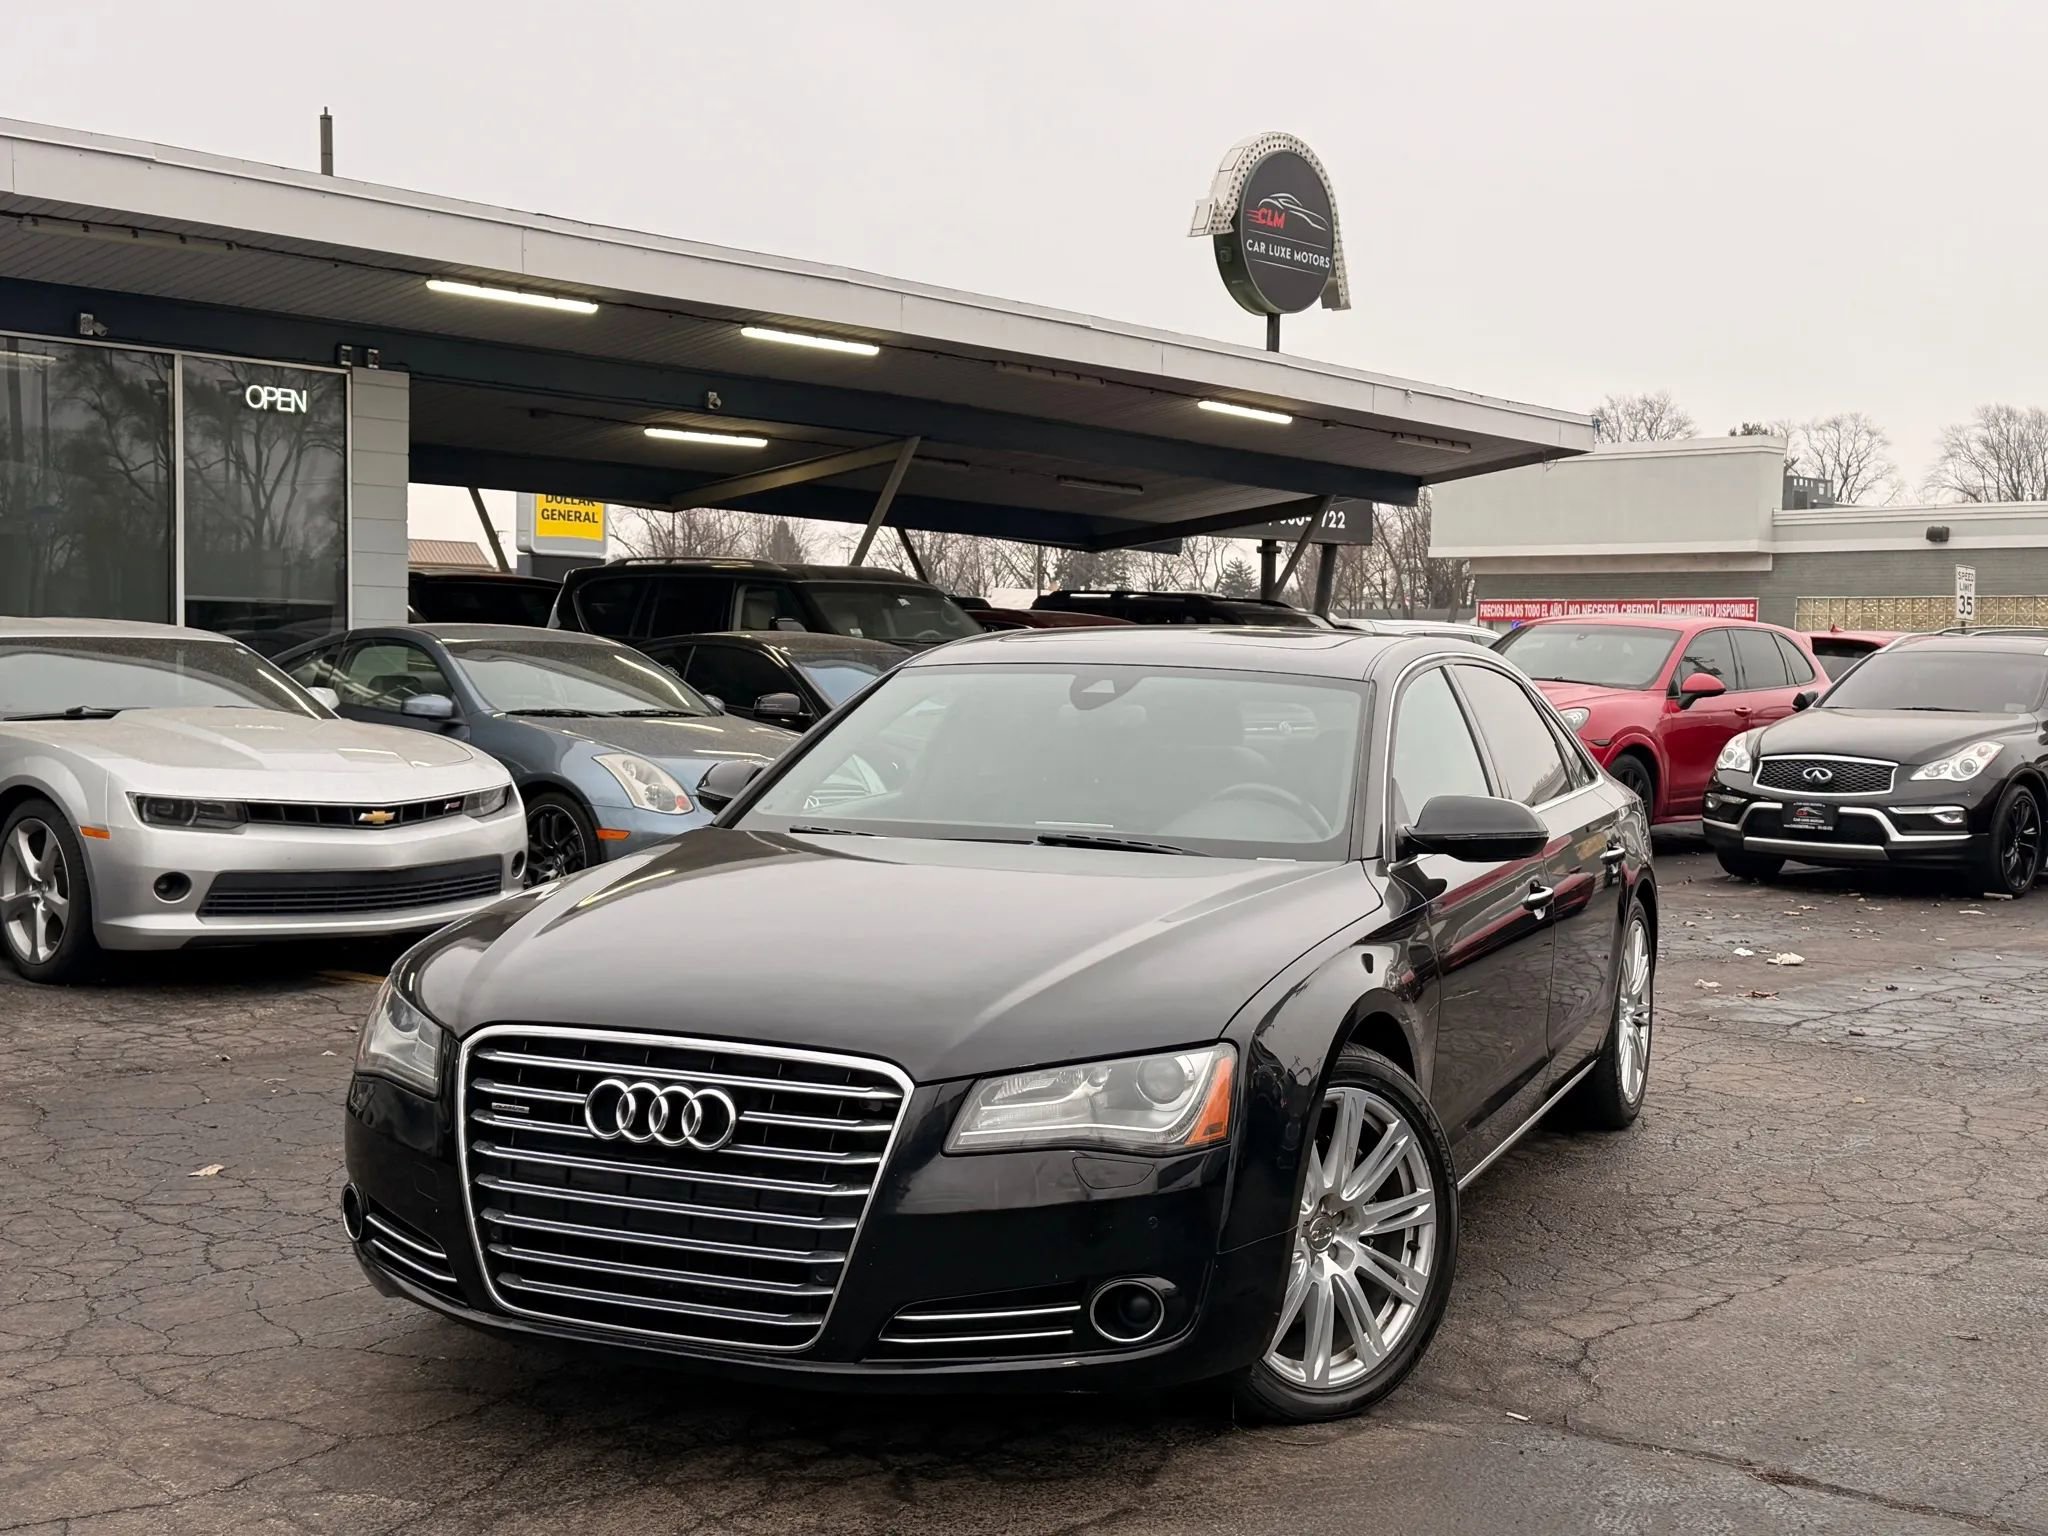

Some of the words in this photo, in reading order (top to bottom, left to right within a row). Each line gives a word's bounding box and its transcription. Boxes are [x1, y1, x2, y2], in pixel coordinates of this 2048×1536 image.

[1256, 207, 1286, 229] CLM
[1246, 239, 1265, 254] CAR
[1269, 243, 1292, 260] LUXE
[1294, 251, 1330, 269] MOTORS
[245, 384, 307, 414] OPEN
[541, 508, 599, 524] GENERAL
[1480, 603, 1504, 617] PRECIOS
[1505, 603, 1524, 617] BAJOS
[1525, 603, 1540, 617] TODO
[1541, 604, 1549, 617] EL
[1569, 603, 1580, 615] NO
[1716, 603, 1755, 617] DISPONIBLE
[1958, 595, 1973, 616] 35
